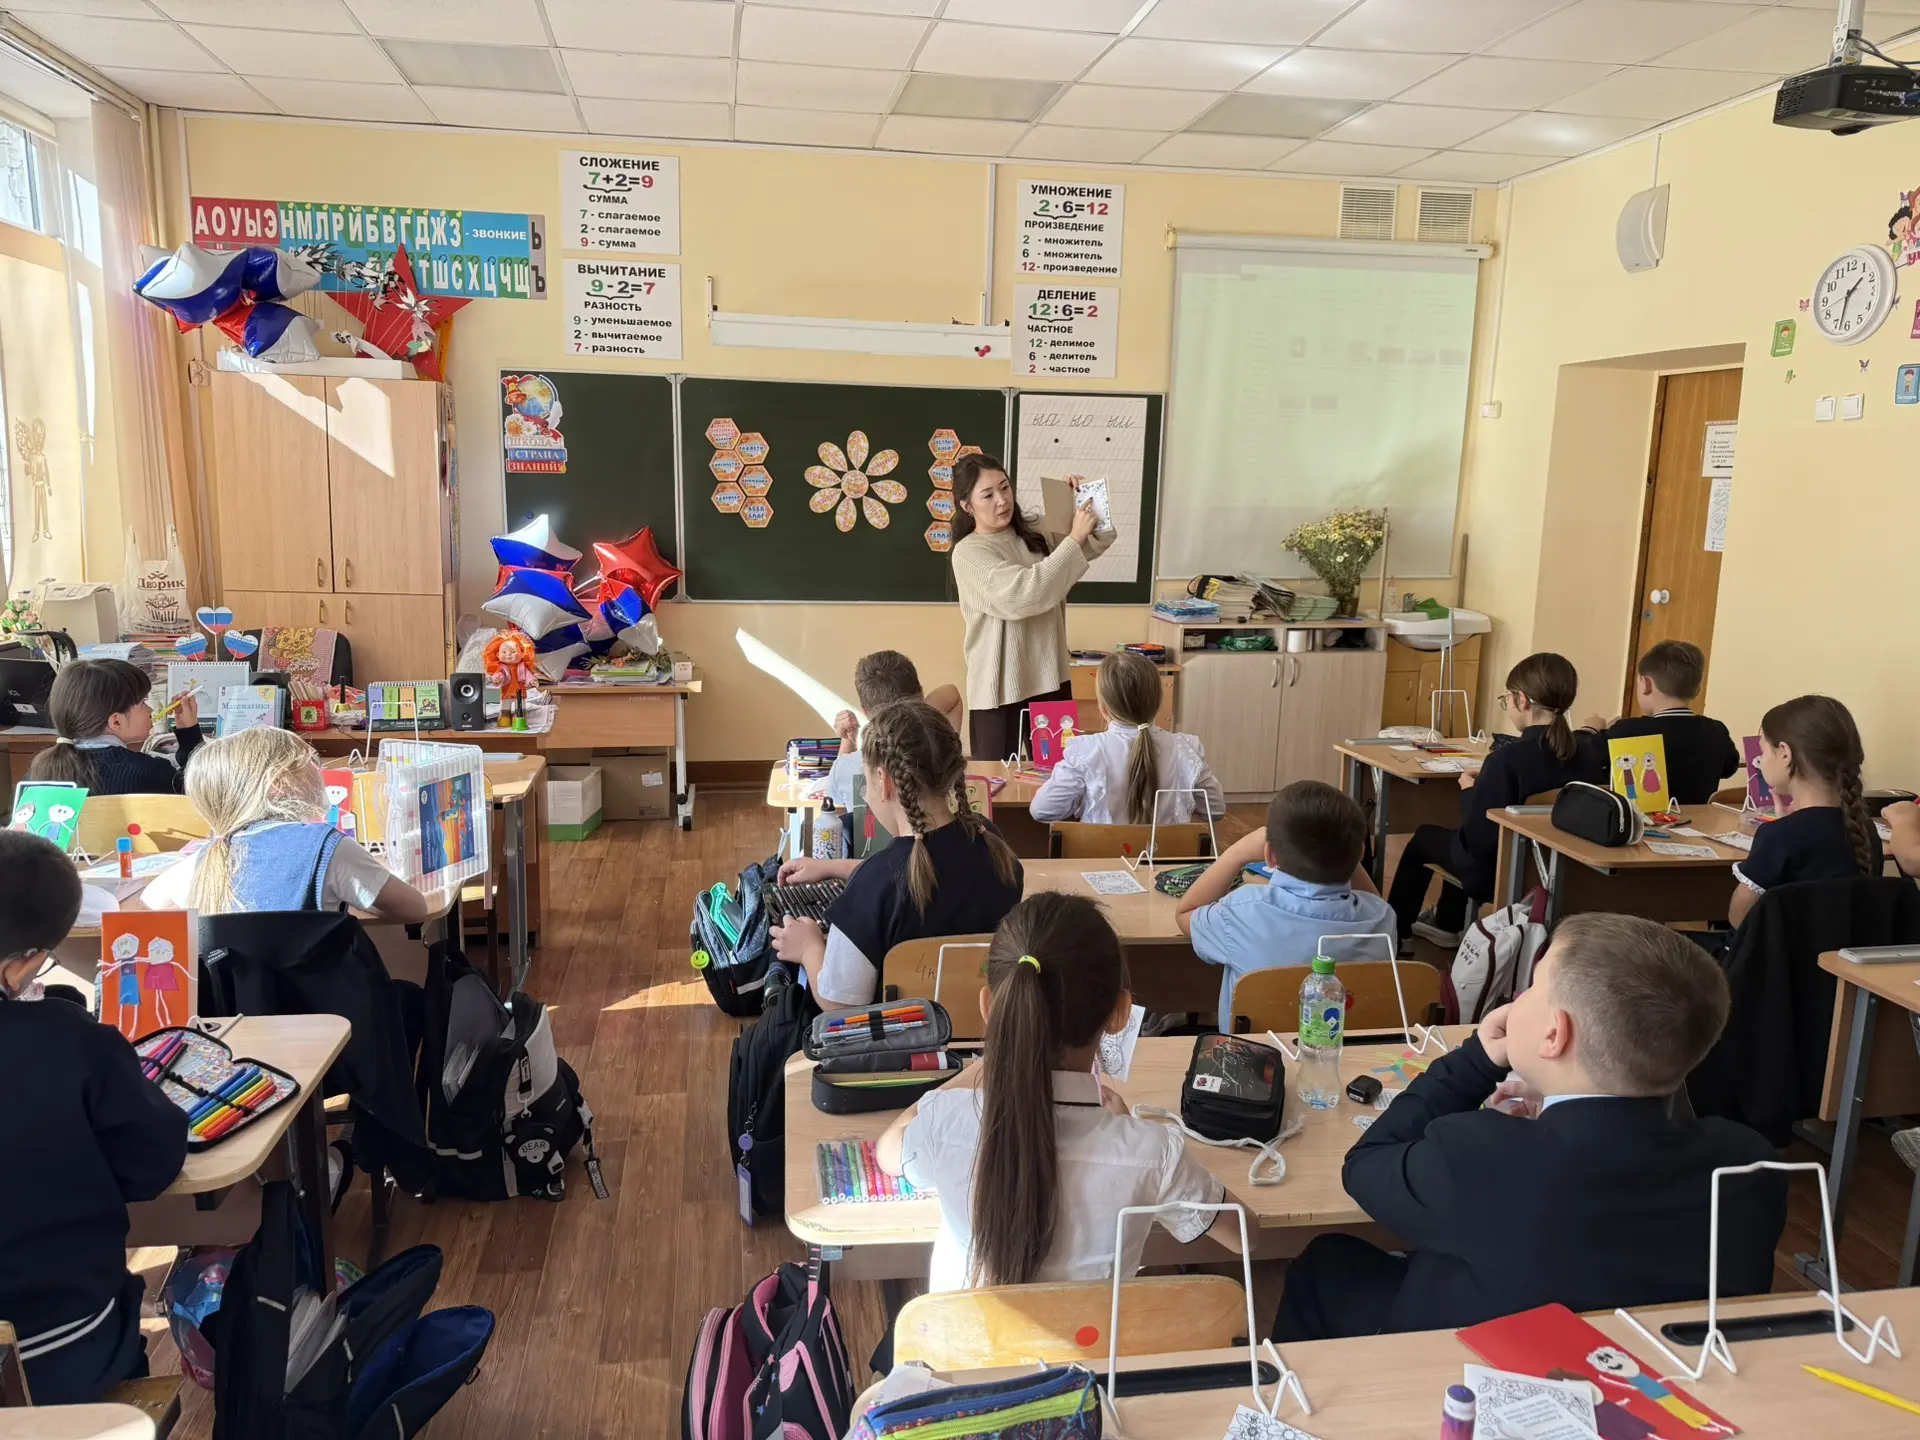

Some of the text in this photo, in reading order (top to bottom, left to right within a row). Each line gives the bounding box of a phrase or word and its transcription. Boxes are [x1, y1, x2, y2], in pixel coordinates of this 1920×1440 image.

[580, 156, 660, 171] СЛОЖЕНИЕ
[1031, 184, 1112, 199] УМНОЖЕНИЕ
[588, 194, 628, 204] СУММА
[580, 209, 588, 219] 7
[598, 211, 661, 222] слагаемое
[580, 224, 588, 234] 2
[598, 226, 661, 236] слагаемое
[1024, 220, 1104, 232] ПРОИЗВЕДЕНИЕ
[472, 228, 527, 241] ЗВОНКИЕ
[1022, 234, 1030, 244] 2
[1044, 237, 1103, 247] множитель
[580, 237, 588, 247] 9
[598, 239, 636, 249] сумма
[1022, 248, 1030, 258] 6
[1044, 251, 1103, 260] множитель
[577, 264, 666, 278] ВЫЧИТАНИЕ
[1043, 263, 1118, 274] произведение
[1846, 260, 1858, 272] 12
[1862, 262, 1866, 273] 1
[1836, 268, 1845, 280] 11
[1868, 272, 1875, 283] 2
[1827, 281, 1837, 293] 10
[1037, 290, 1096, 301] ДЕЛЕНИЕ
[1822, 296, 1828, 307] 9
[584, 301, 642, 312] РАЗНОСТЬ
[1865, 300, 1872, 312] 4
[1824, 309, 1831, 320] 8
[1857, 314, 1863, 325] 5
[573, 315, 581, 325] 9
[591, 317, 672, 328] уменьшаемое
[1833, 318, 1839, 330] 7
[1844, 320, 1851, 332] 6
[1028, 324, 1073, 334] ЧАСТНОЕ
[574, 330, 582, 339] 2
[591, 331, 662, 342] вычитаемое
[574, 343, 582, 352] 7
[592, 344, 645, 354] разность
[1049, 340, 1095, 348] делимое
[1029, 352, 1036, 361] 6
[1049, 353, 1097, 361] делитель
[1029, 364, 1036, 374] 2
[1049, 366, 1090, 374] частное
[511, 438, 552, 447] ШКОЛА
[515, 450, 559, 459] СТРАНА
[137, 578, 185, 591] Дворик
[222, 702, 270, 710] Математика
[521, 1141, 546, 1154] BEAR
